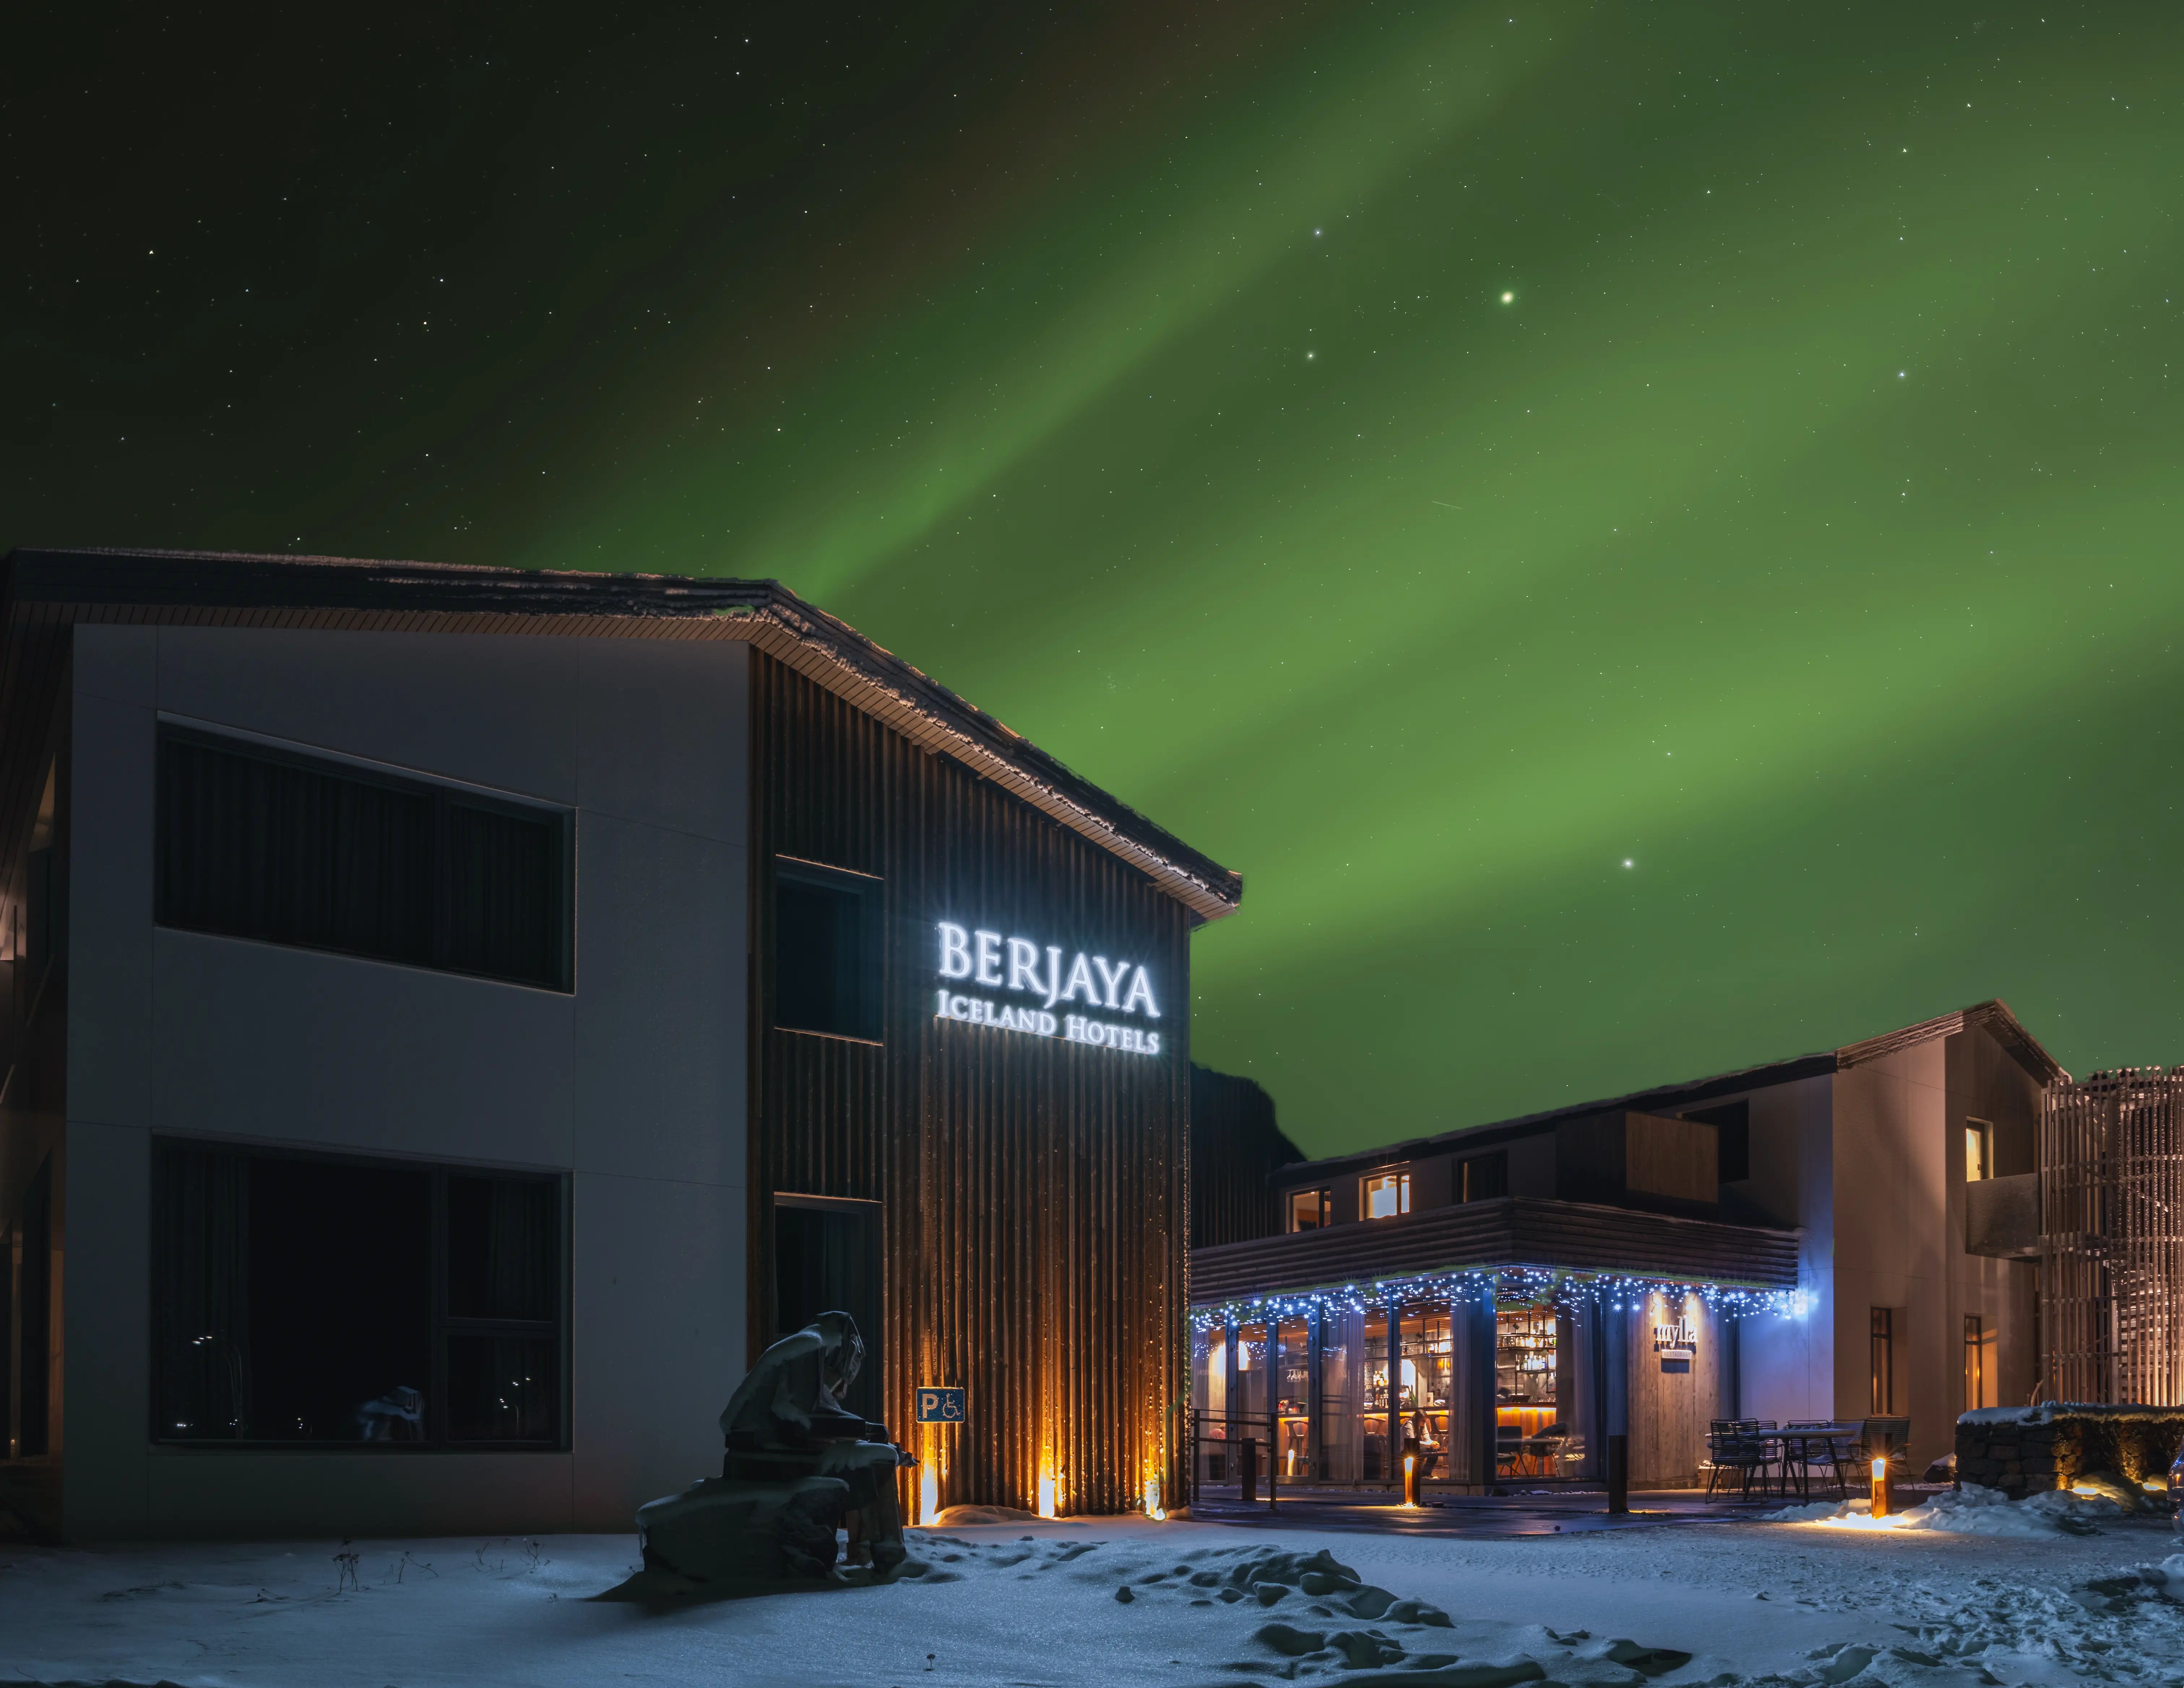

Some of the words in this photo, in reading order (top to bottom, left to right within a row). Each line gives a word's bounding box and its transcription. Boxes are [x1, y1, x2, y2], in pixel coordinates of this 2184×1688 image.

[939, 922, 1160, 1017] BERJAYA
[1654, 1314, 1698, 1349] mylla
[922, 1394, 938, 1418] P
